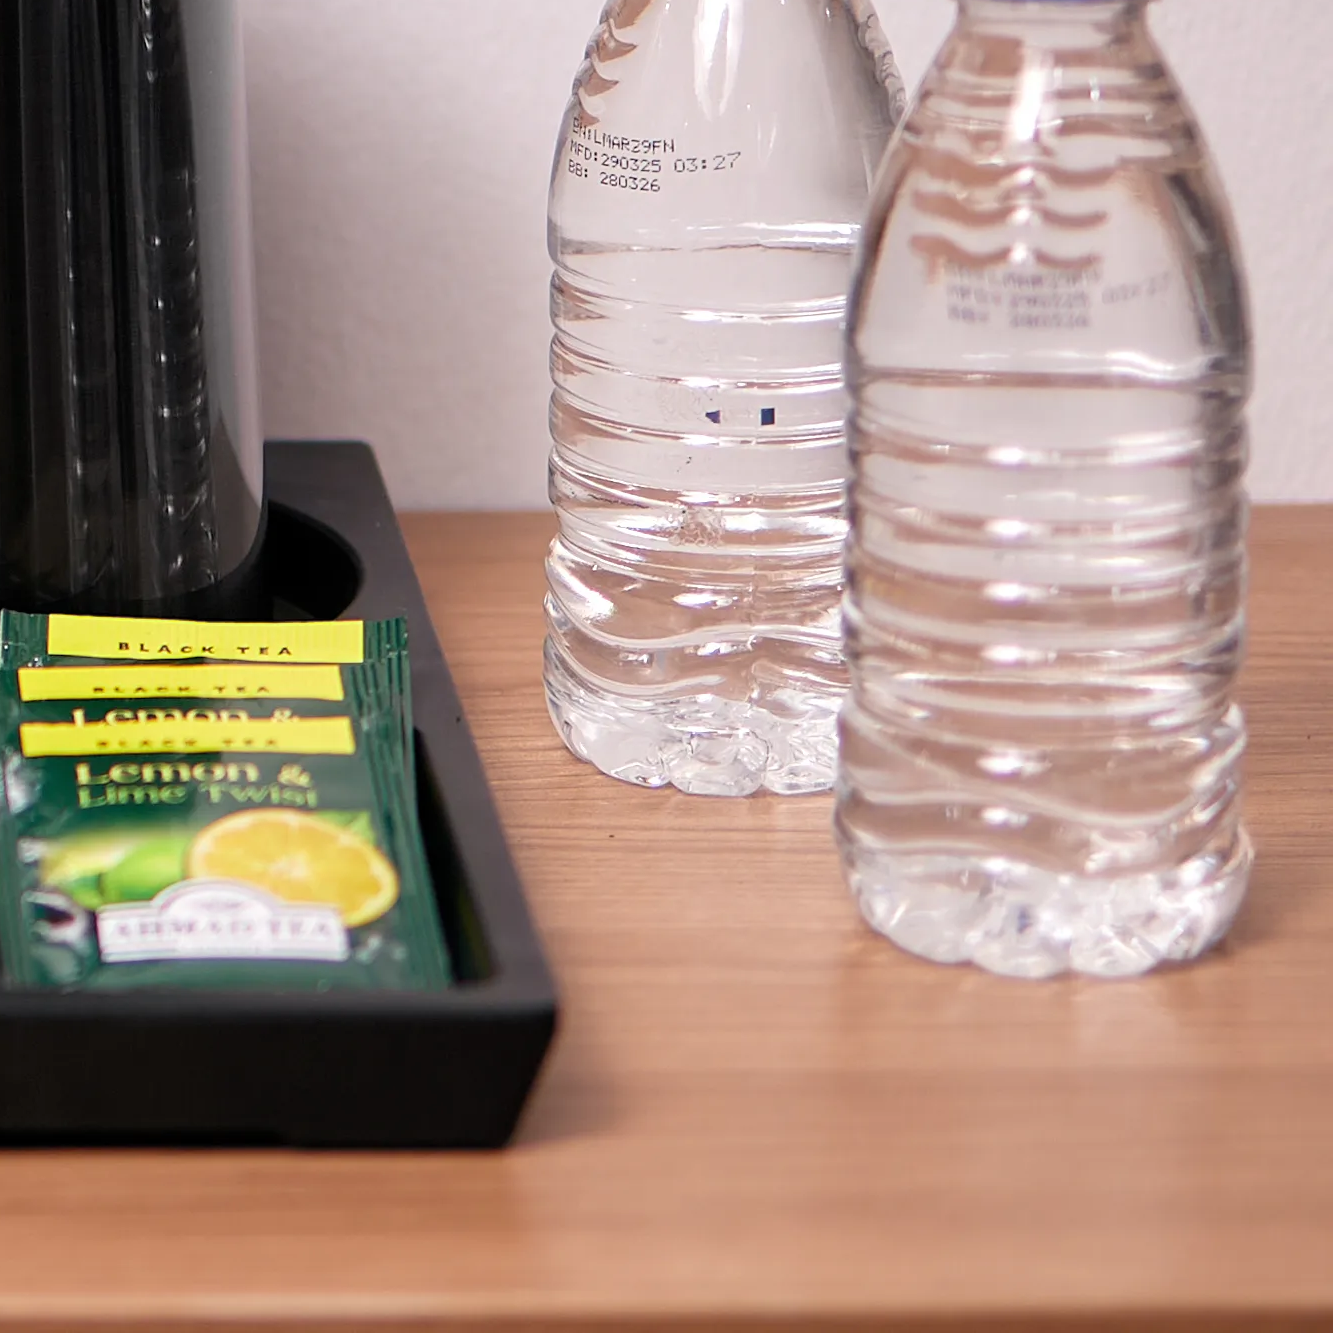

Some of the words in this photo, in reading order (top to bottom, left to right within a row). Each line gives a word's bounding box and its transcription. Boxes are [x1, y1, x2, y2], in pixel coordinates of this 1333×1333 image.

[569, 139, 662, 173] MFD:290325
[674, 151, 741, 173] 03:27
[568, 159, 588, 178] BB:
[599, 171, 661, 192] 280326
[118, 641, 214, 655] BLACK
[237, 645, 293, 655] TEA
[74, 761, 260, 786] Lemon
[277, 763, 313, 788] &
[77, 782, 188, 809] Lime
